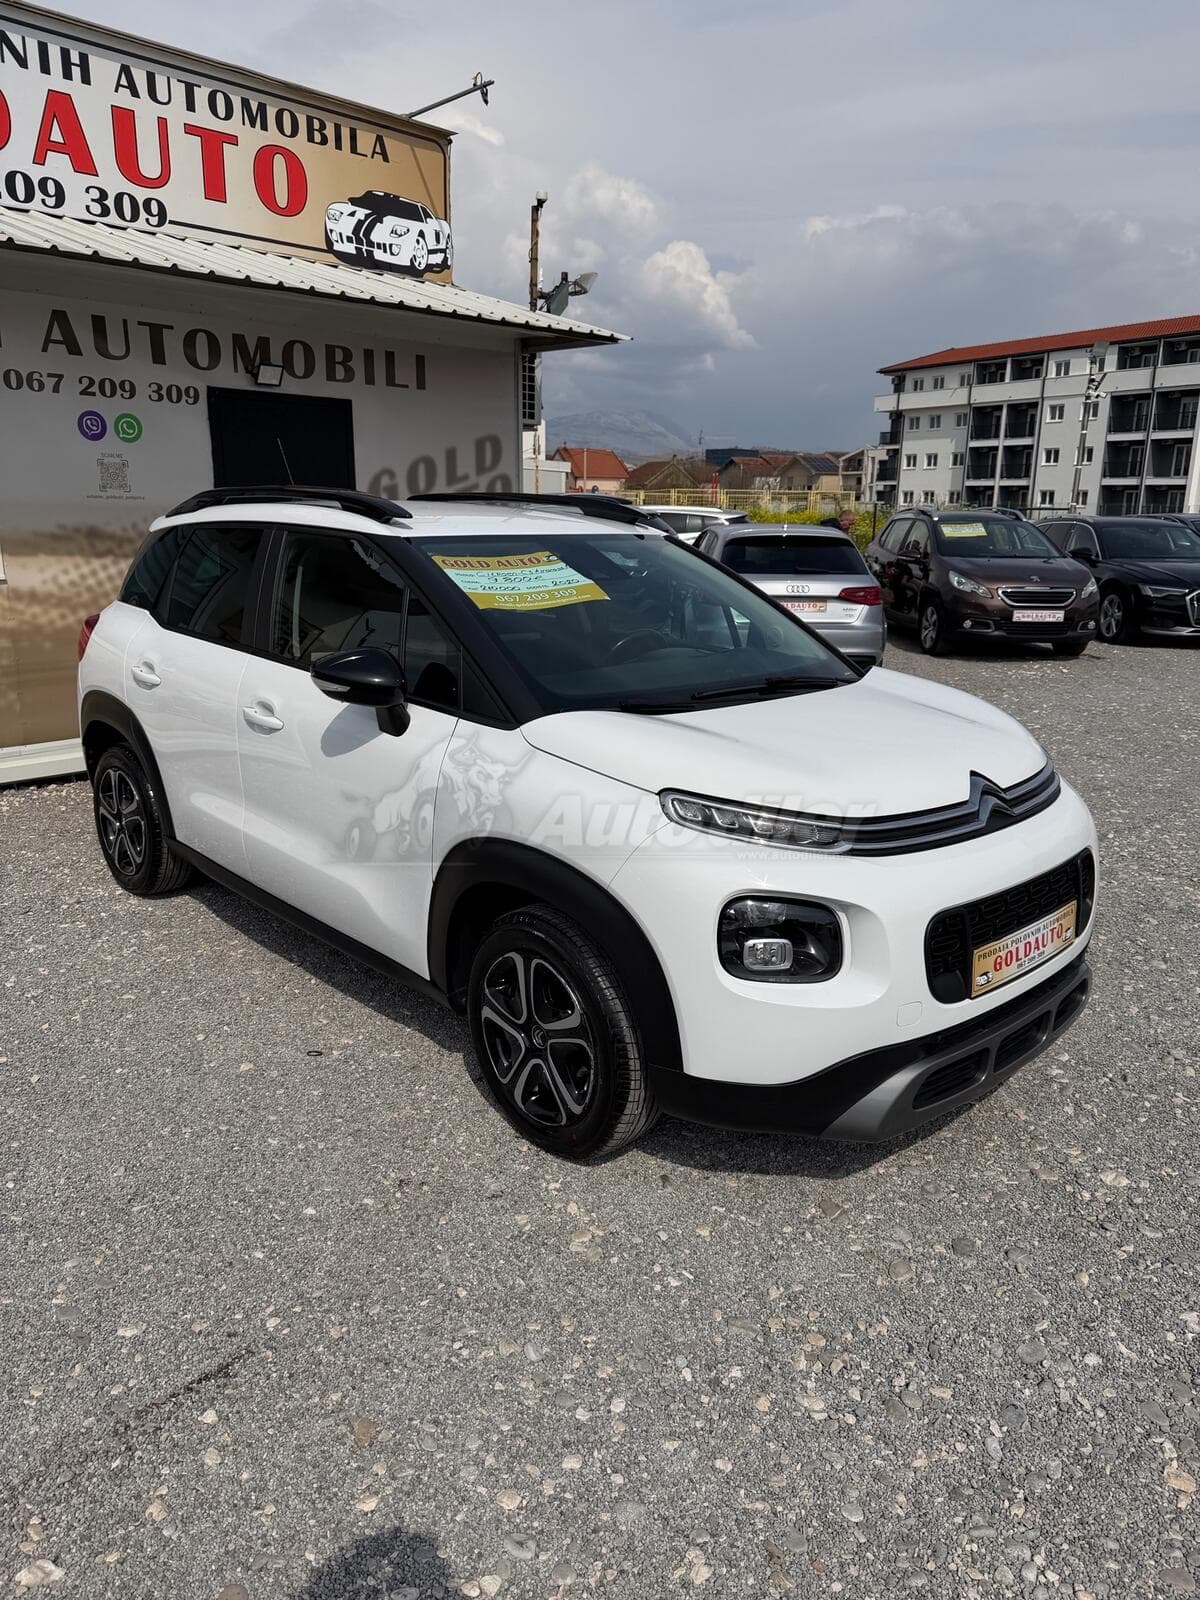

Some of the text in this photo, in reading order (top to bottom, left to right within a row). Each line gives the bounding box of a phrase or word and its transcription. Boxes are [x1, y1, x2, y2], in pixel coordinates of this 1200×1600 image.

[114, 64, 391, 163] AUTOMOBILA
[0, 88, 308, 217] AUTO
[0, 169, 168, 228] 09 309
[41, 309, 427, 391] AUTOMOBILI
[3, 368, 200, 406] 067 209 309
[368, 434, 503, 500] GOLD
[441, 556, 542, 569] GOLD AUTO
[495, 595, 520, 603] 067
[524, 592, 550, 602] 209
[551, 588, 577, 598] 309
[993, 923, 1063, 973] GOLDAUTO
